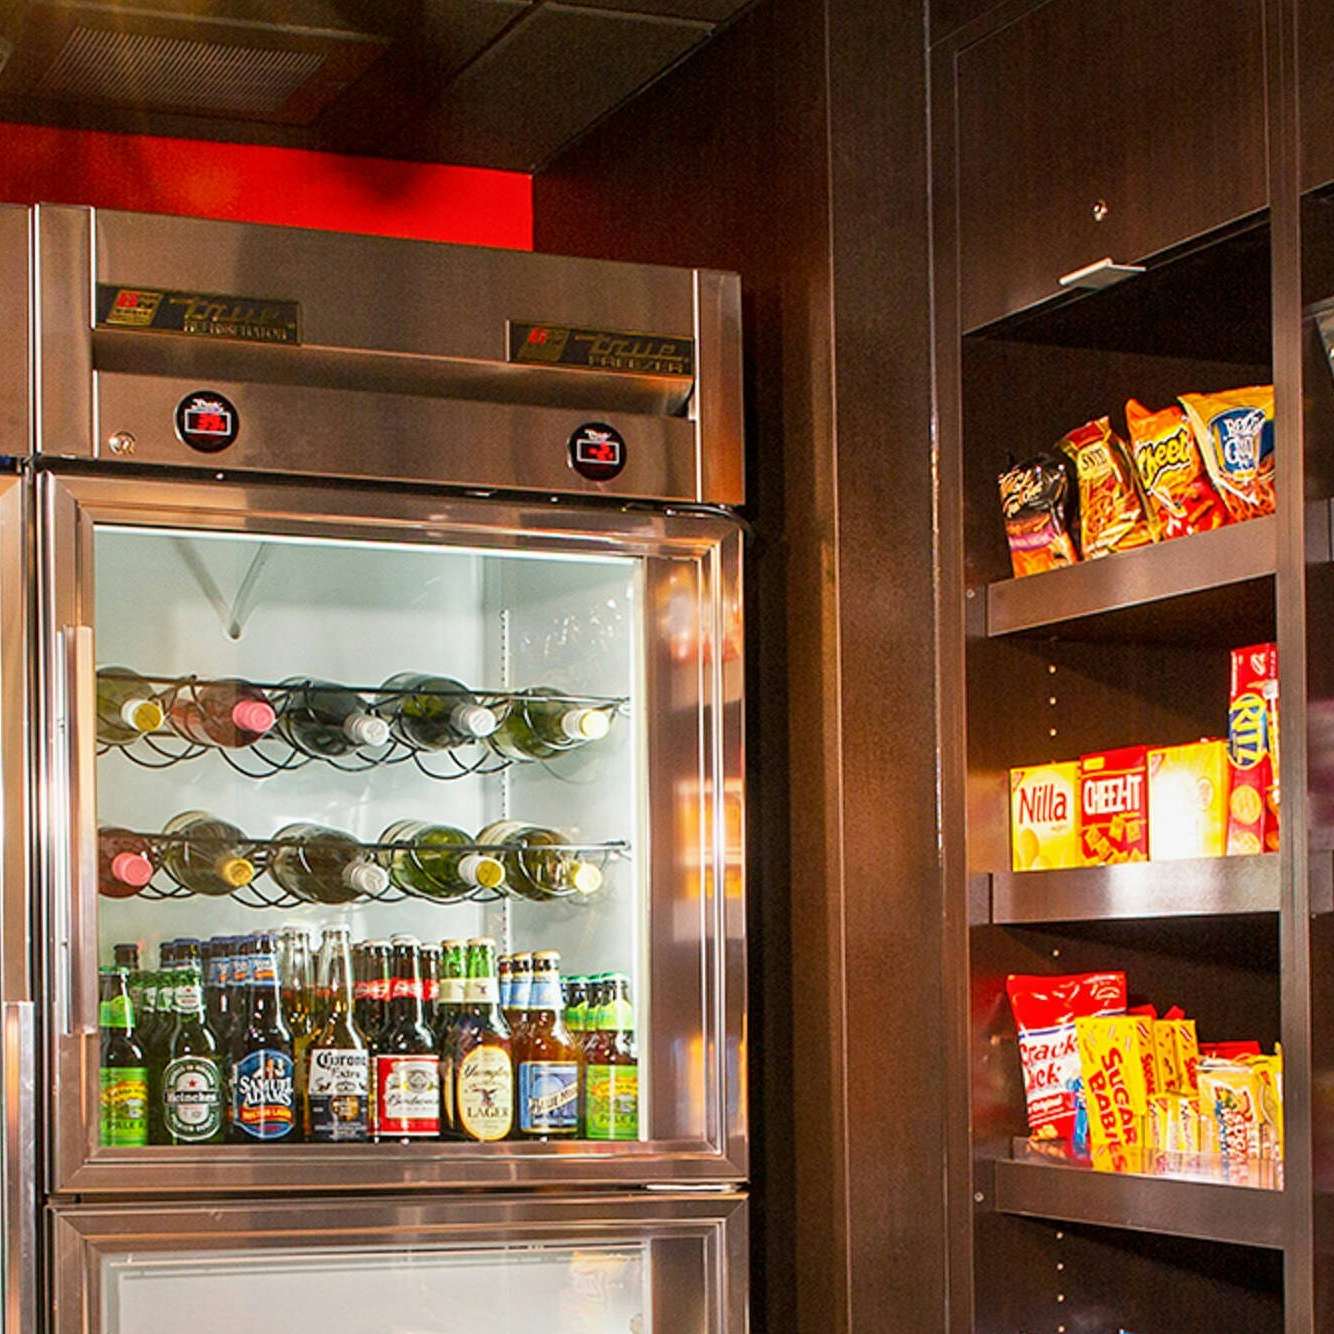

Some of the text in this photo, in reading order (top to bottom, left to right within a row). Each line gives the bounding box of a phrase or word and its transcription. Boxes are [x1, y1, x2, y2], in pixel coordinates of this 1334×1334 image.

[1018, 783, 1068, 825] Nilla
[1083, 773, 1143, 816] CHEEZ-IT
[316, 1052, 367, 1068] Corona
[1019, 1032, 1078, 1066] Crack
[239, 1075, 294, 1095] SAMUEL
[243, 1090, 292, 1106] ADAMS
[1102, 1046, 1138, 1146] SUGAR
[466, 1106, 509, 1119] LAGER
[1088, 1070, 1127, 1172] BABIES
